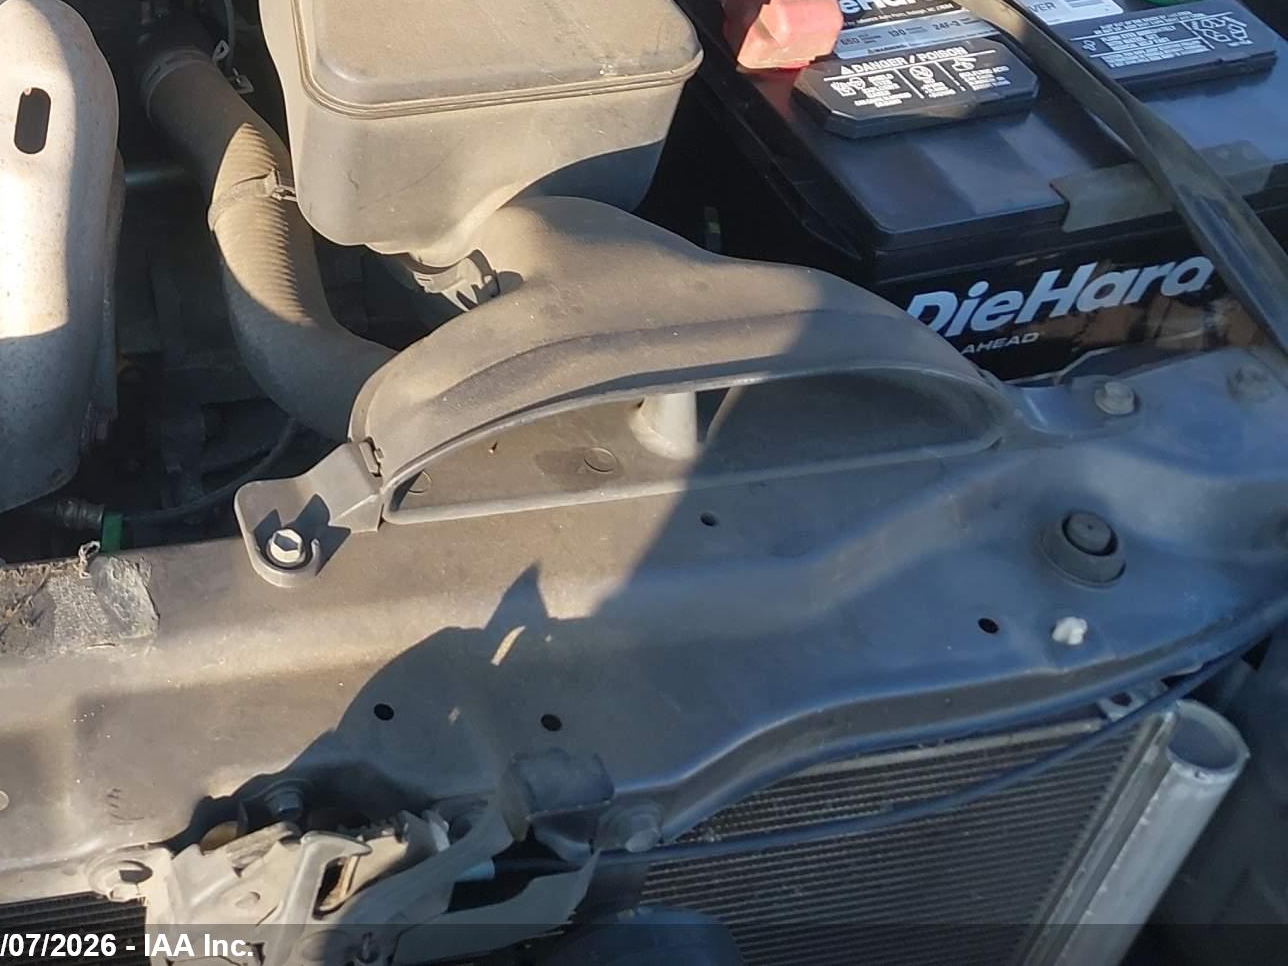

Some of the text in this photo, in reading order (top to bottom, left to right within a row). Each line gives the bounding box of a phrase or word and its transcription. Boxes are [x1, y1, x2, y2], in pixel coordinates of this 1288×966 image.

[852, 56, 908, 73] DANGER
[918, 47, 969, 62] POISON
[962, 332, 1040, 355] AHEAD
